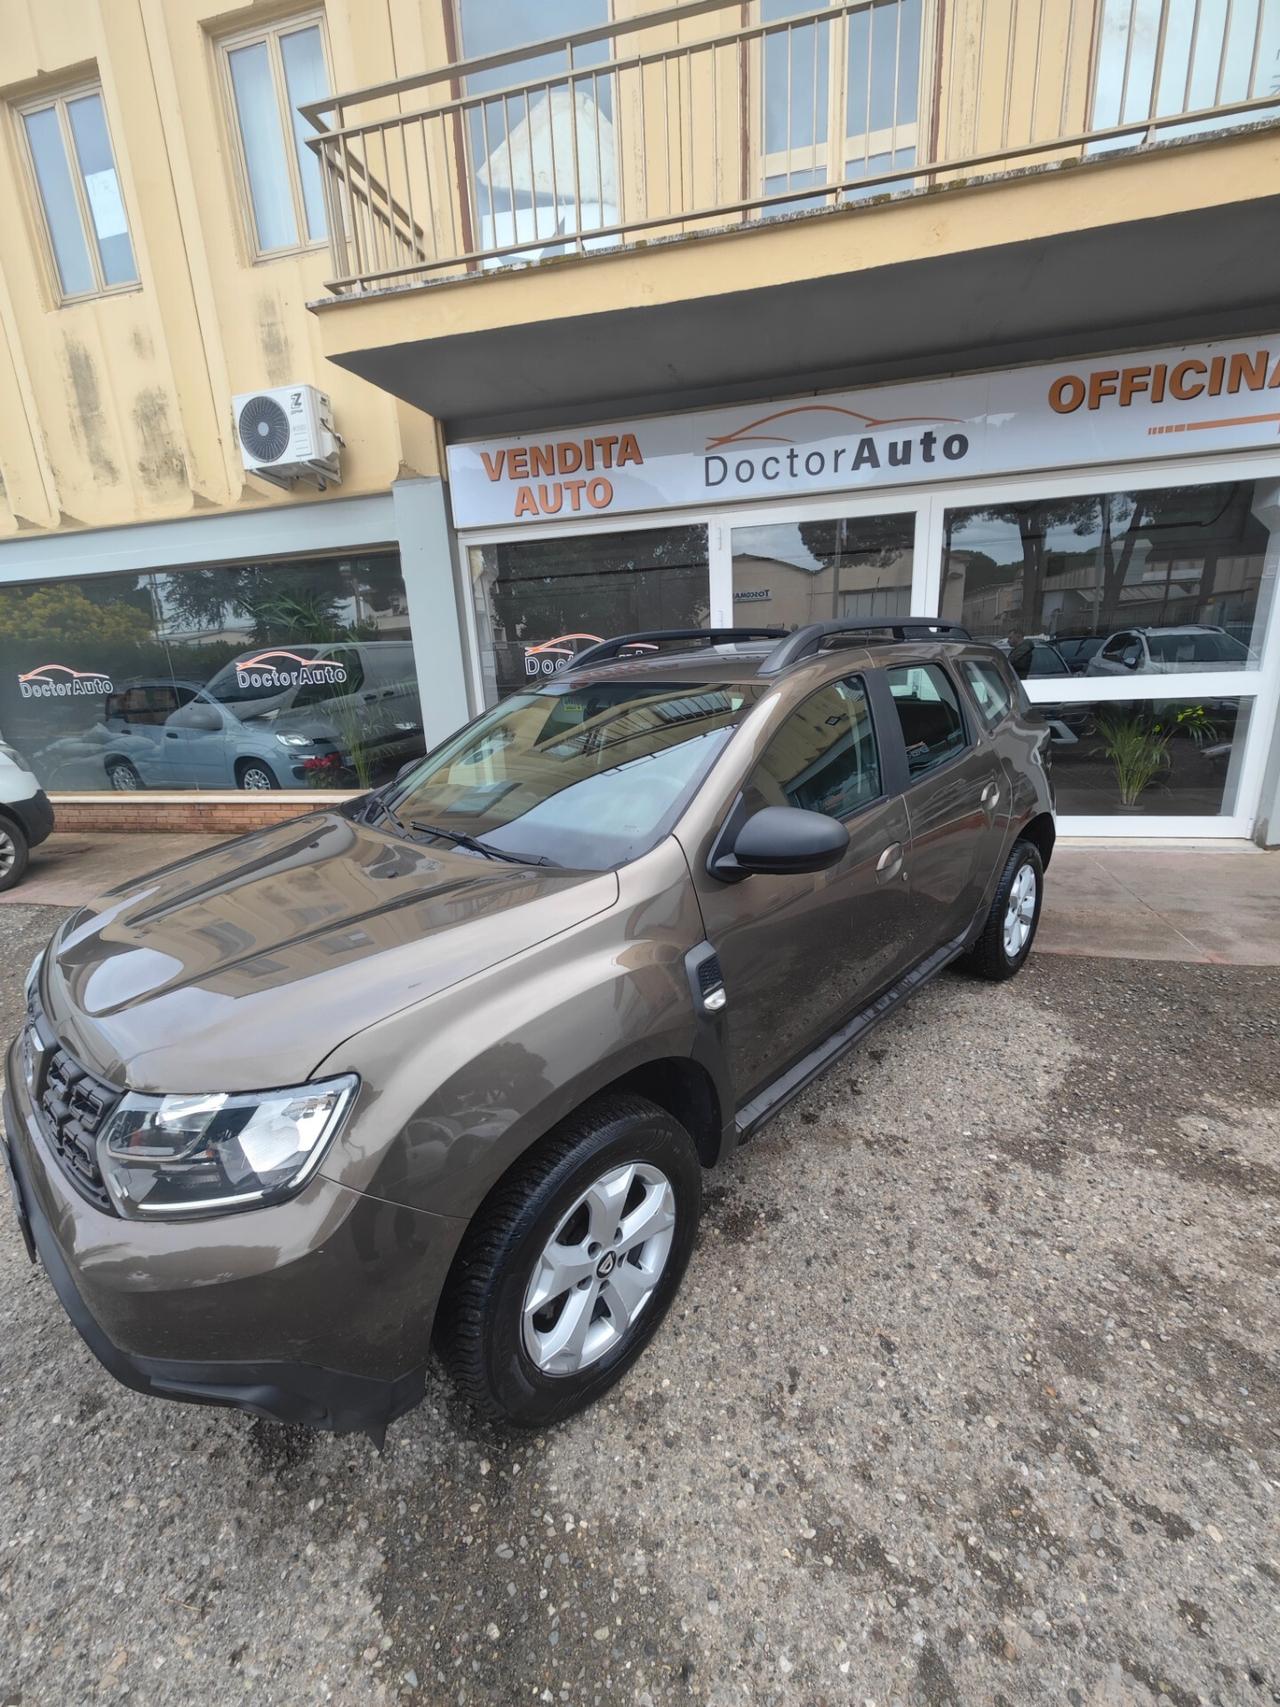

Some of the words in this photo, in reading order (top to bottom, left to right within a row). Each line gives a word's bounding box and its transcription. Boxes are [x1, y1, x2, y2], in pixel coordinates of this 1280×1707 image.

[480, 434, 643, 481] VENDITA
[704, 431, 968, 487] DoctorAuto
[514, 477, 613, 516] AUTO
[19, 679, 113, 698] DoctorAuto
[237, 666, 347, 688] DoctorAuto
